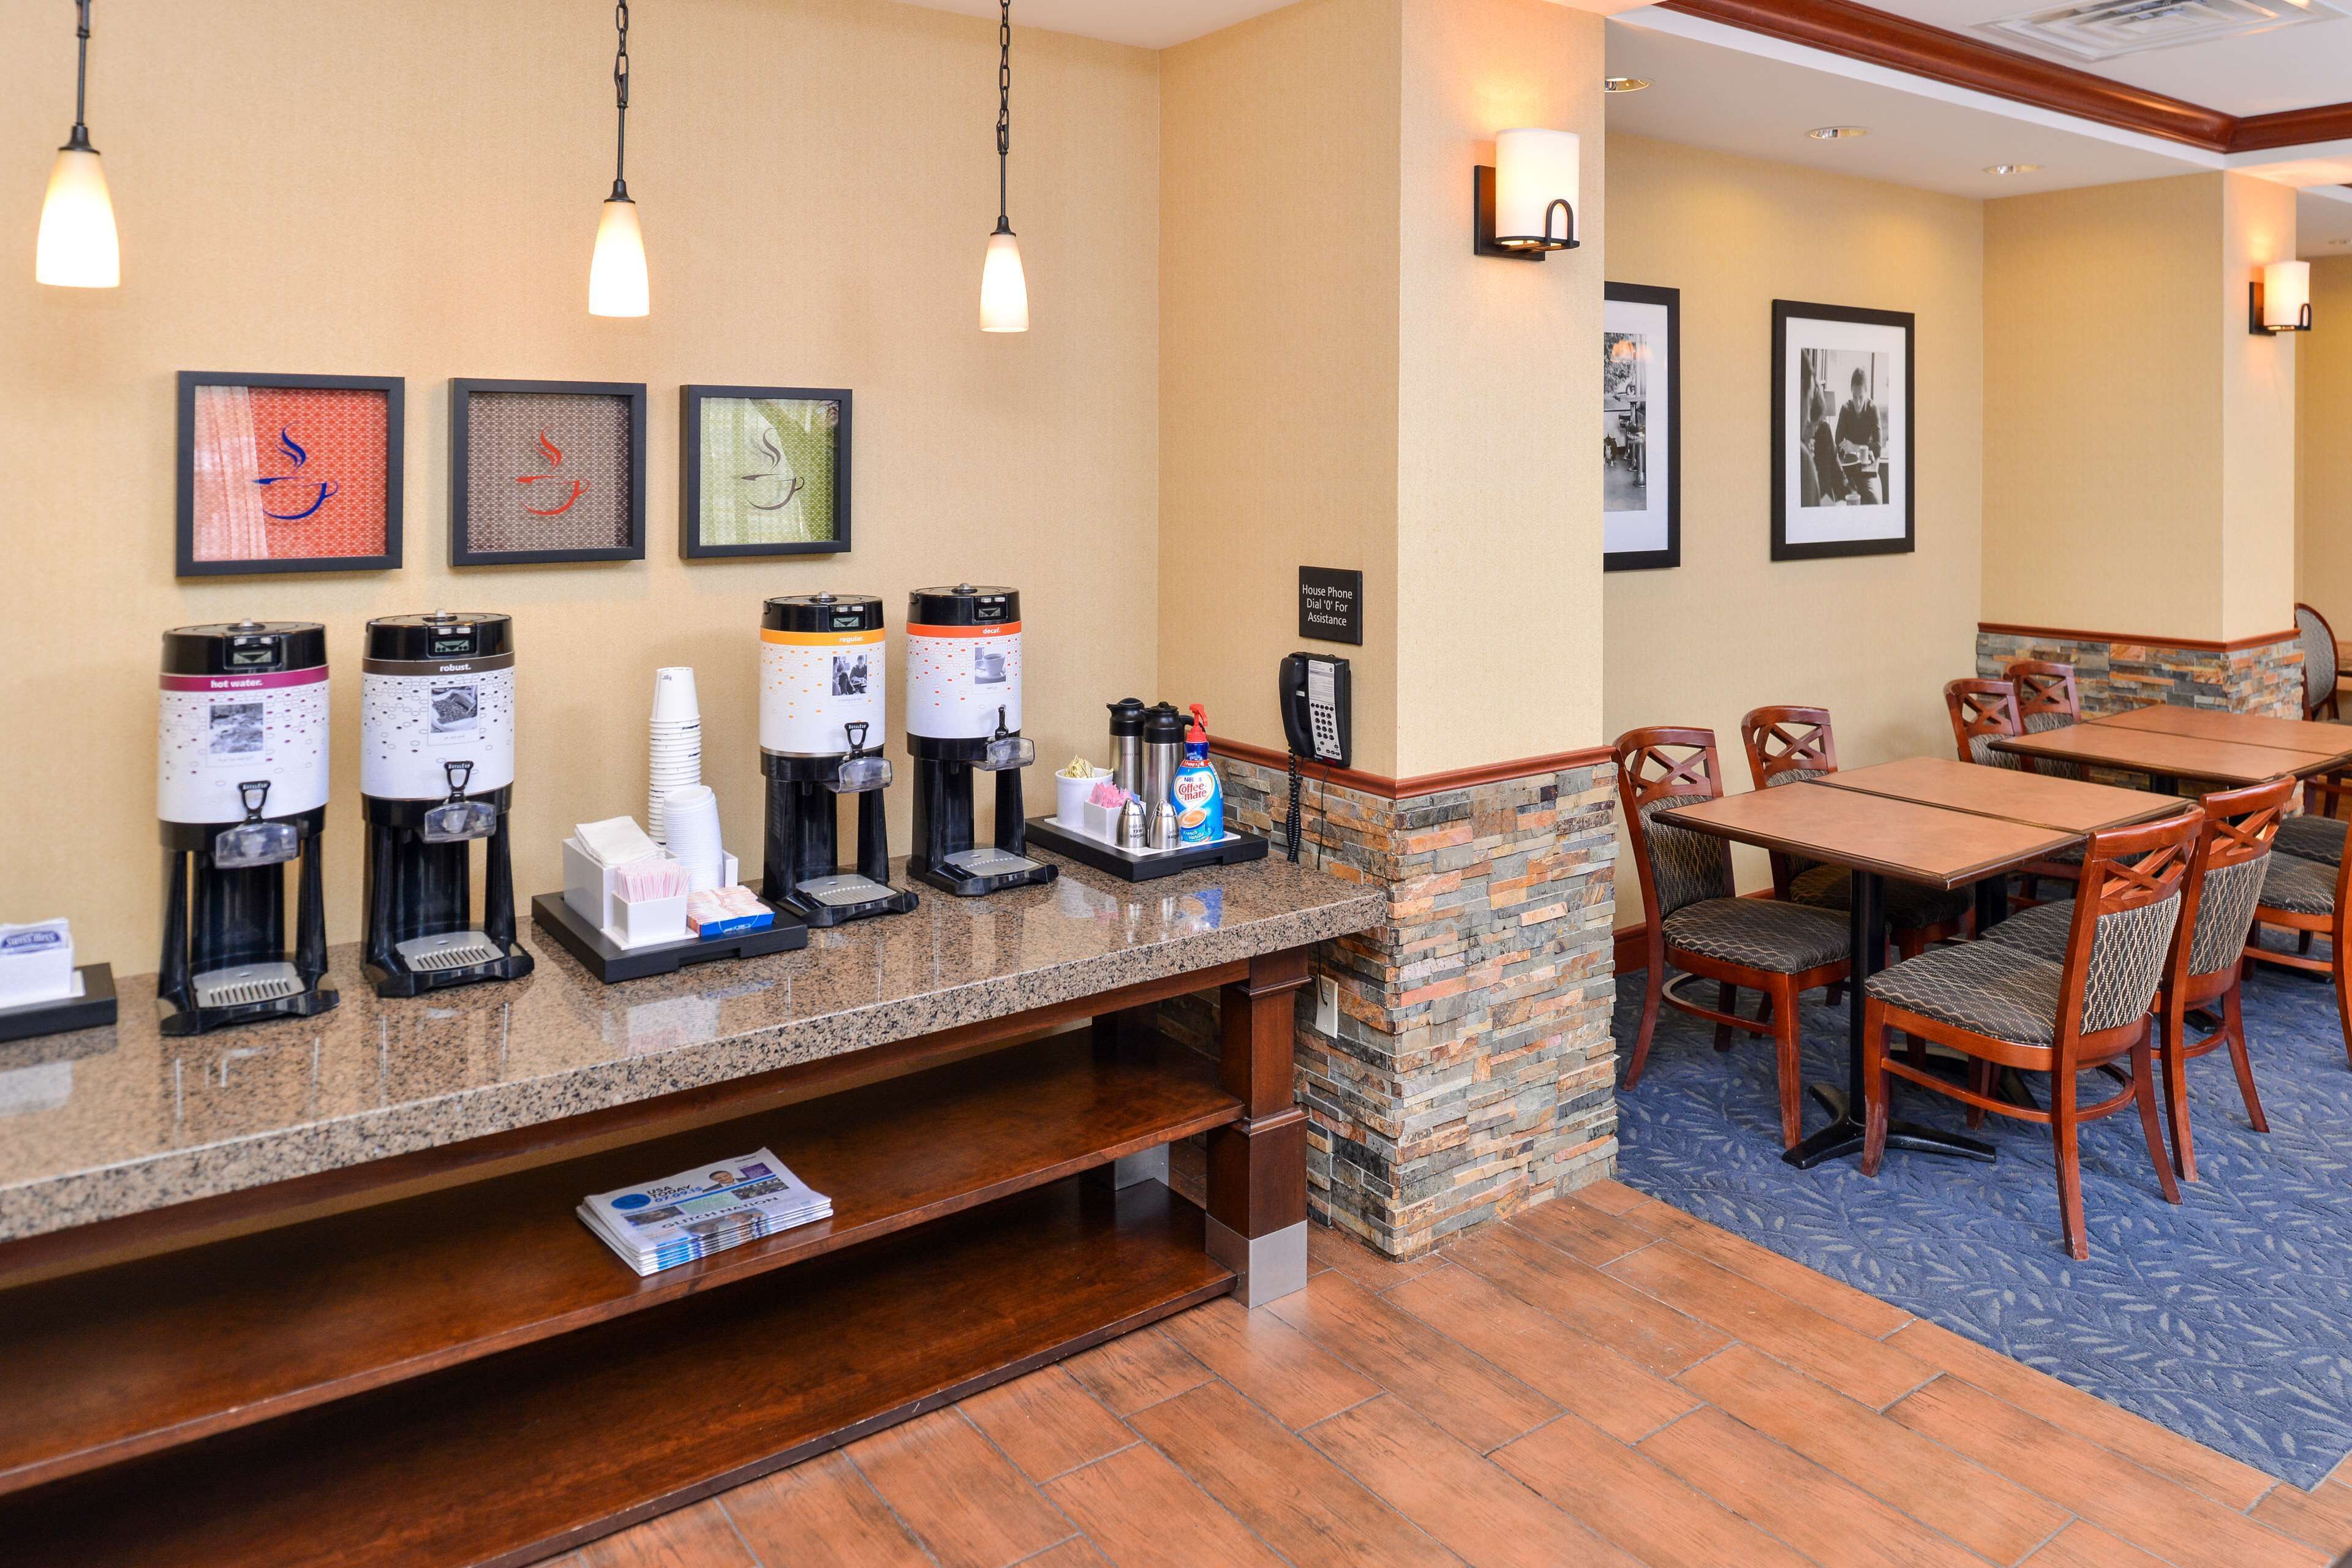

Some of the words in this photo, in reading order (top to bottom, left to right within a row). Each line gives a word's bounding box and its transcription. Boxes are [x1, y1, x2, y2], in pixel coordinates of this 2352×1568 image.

[1302, 584, 1325, 596] House
[1328, 586, 1352, 599] Phone
[1306, 598, 1321, 609] Dial
[1335, 601, 1348, 612] For
[1308, 612, 1347, 626] Assistance
[440, 663, 472, 672] robust.
[210, 680, 229, 688] hot
[230, 679, 263, 688] water.
[1185, 790, 1207, 801] mate
[647, 1186, 673, 1194] USA
[650, 1185, 691, 1198] TODAY
[655, 1186, 703, 1202] 07.09.15
[662, 1212, 717, 1228] GLITCH
[720, 1197, 778, 1214] NATION
